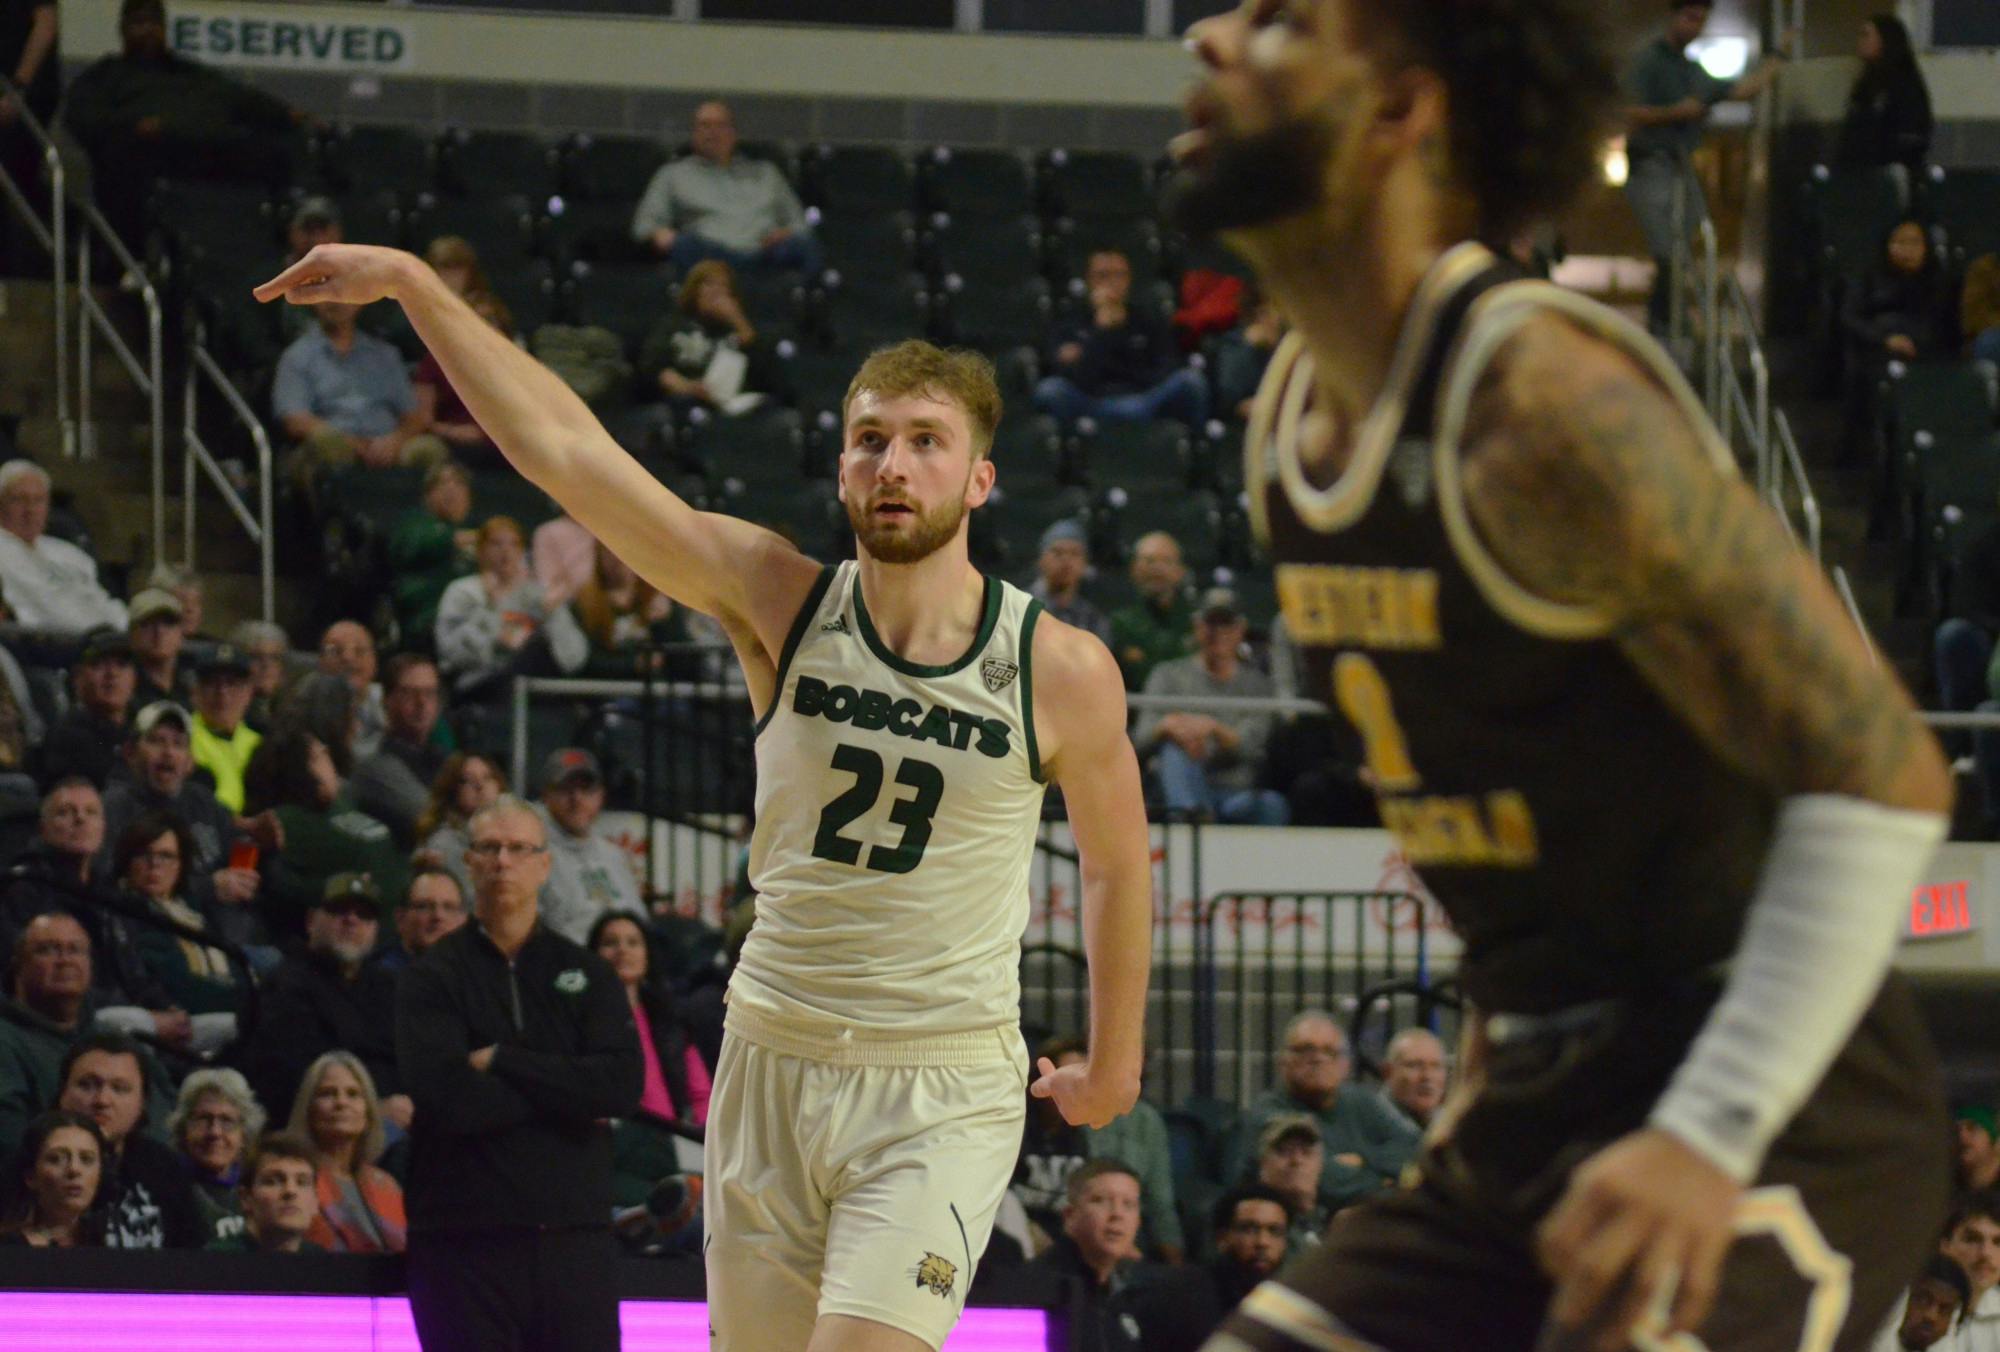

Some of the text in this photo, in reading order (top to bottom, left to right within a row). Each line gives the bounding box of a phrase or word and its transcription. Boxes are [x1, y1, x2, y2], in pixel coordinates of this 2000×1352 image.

[173, 16, 406, 62] ESERVED
[793, 675, 1012, 758] BOBCATS
[811, 743, 945, 875] 23
[1911, 880, 1970, 935] EXIT
